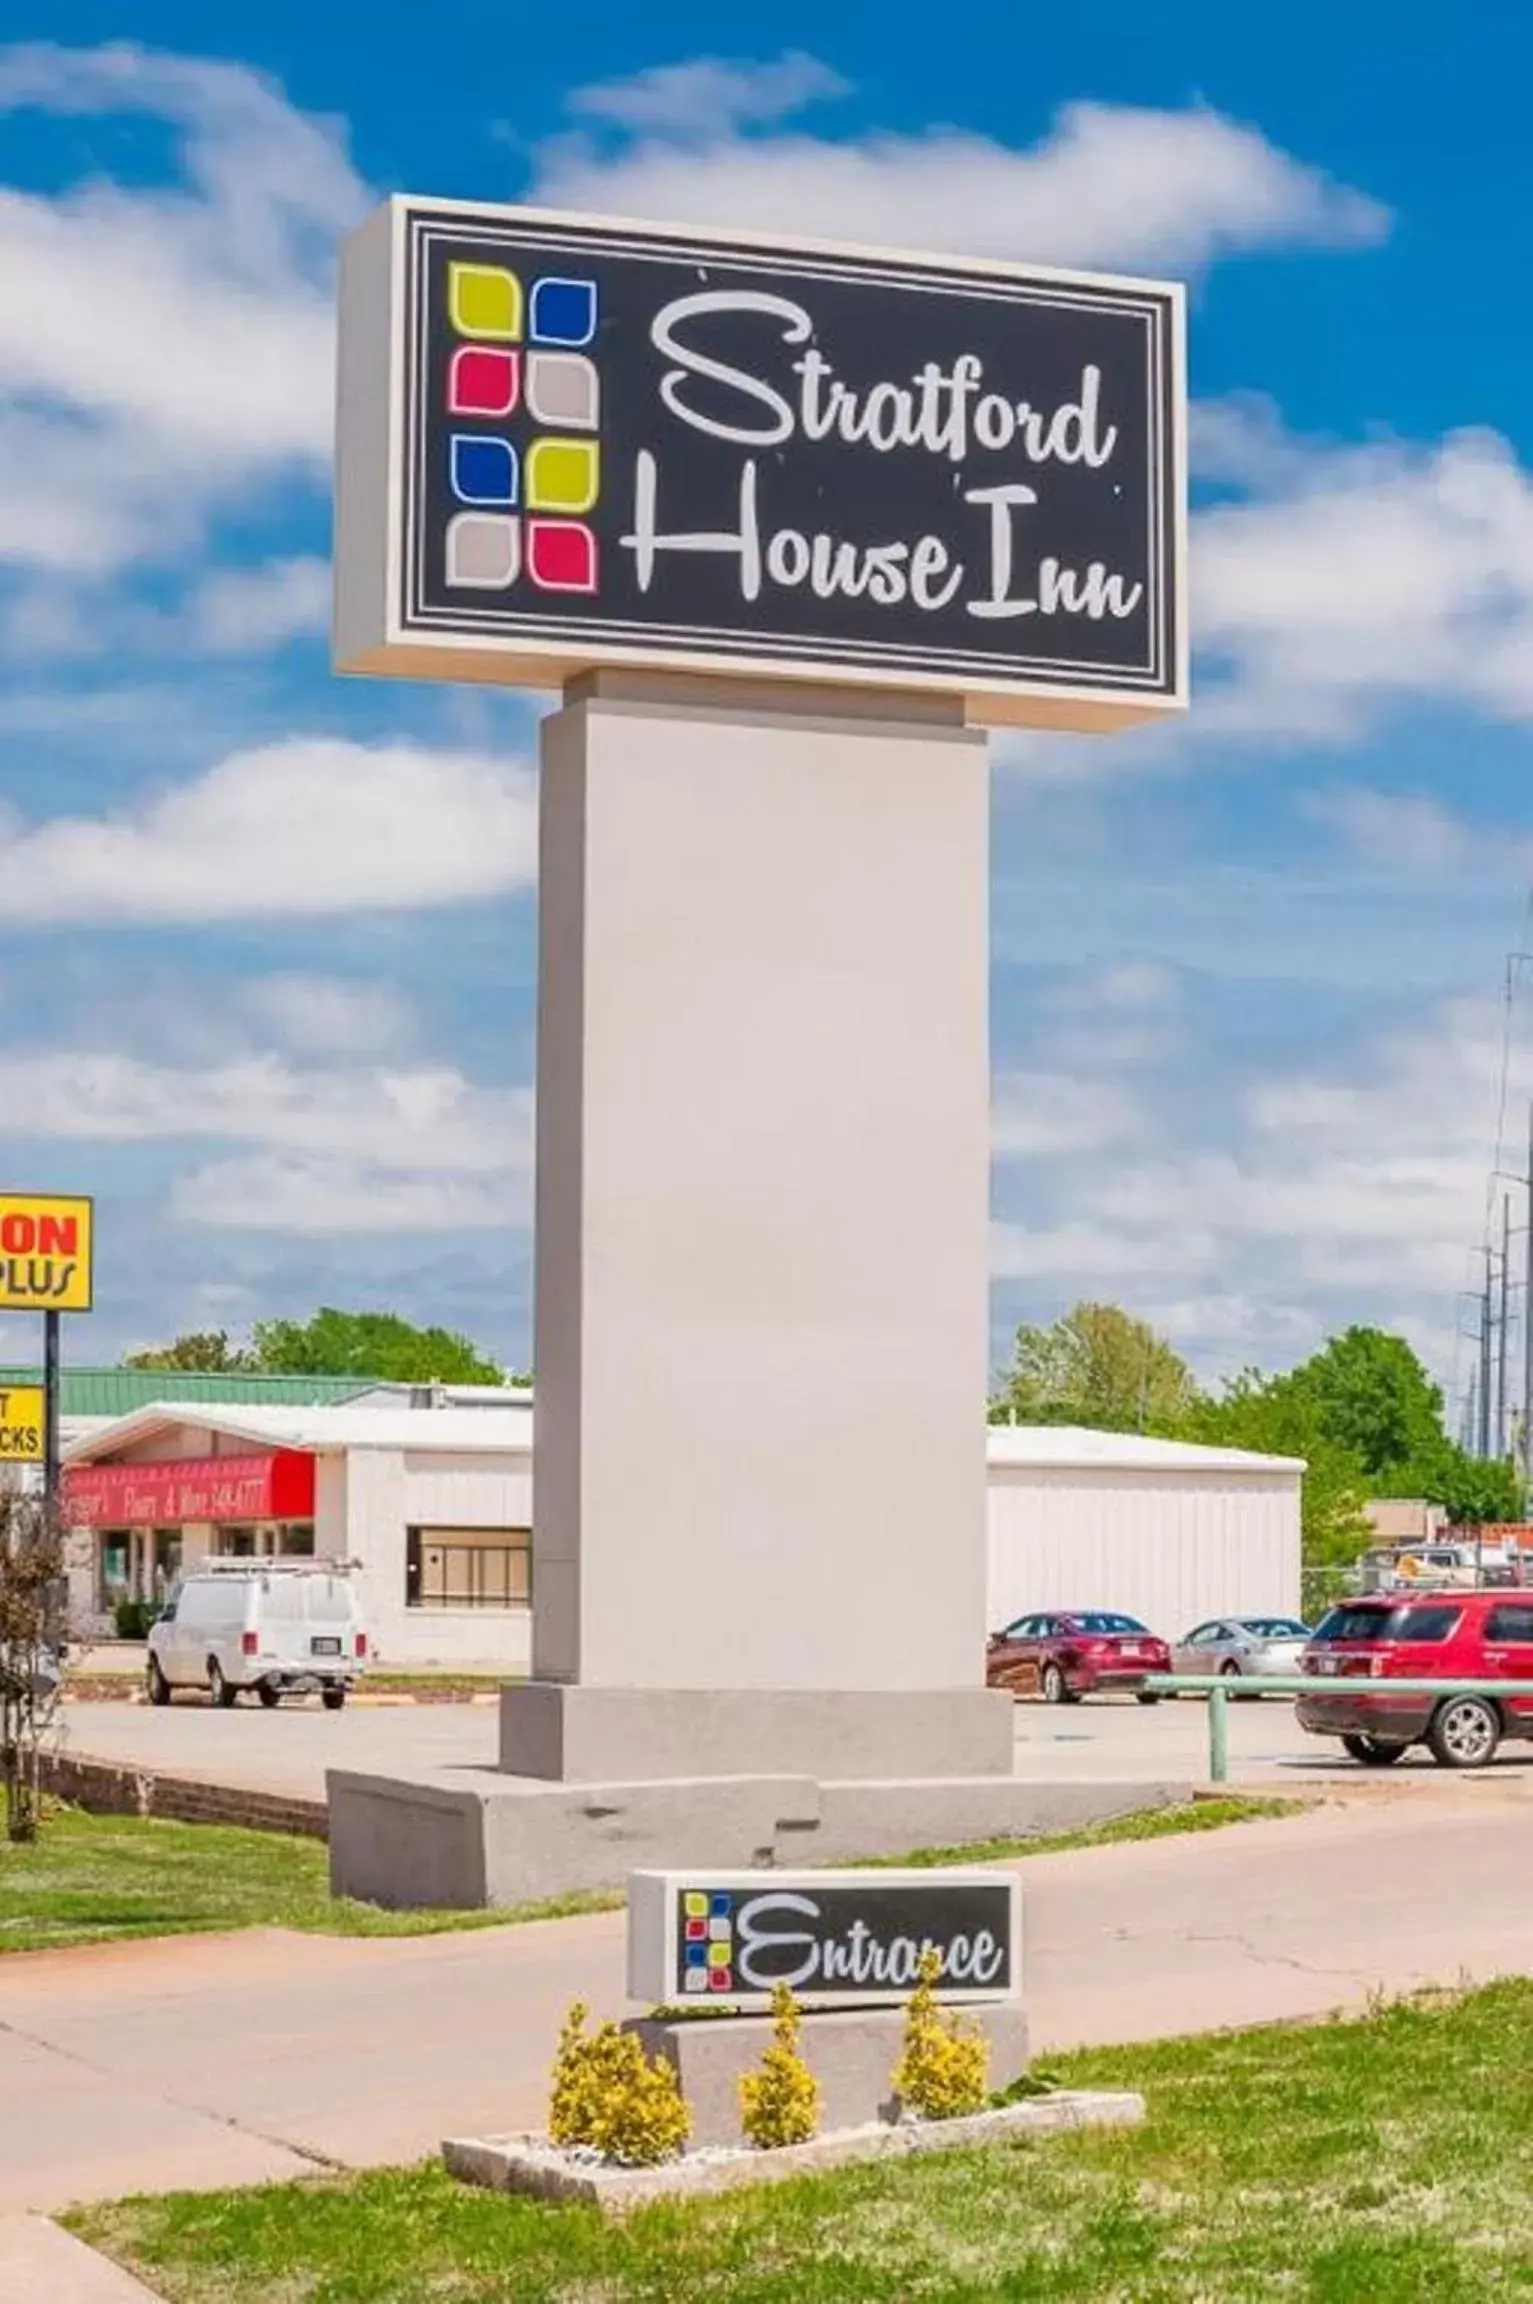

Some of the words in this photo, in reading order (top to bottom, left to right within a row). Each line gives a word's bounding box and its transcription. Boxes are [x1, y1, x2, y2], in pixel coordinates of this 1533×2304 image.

[651, 290, 1117, 468] Stratford
[620, 450, 963, 610] House
[965, 485, 1143, 618] Inn
[0, 1259, 77, 1296] LUS
[2, 1213, 77, 1255] ON
